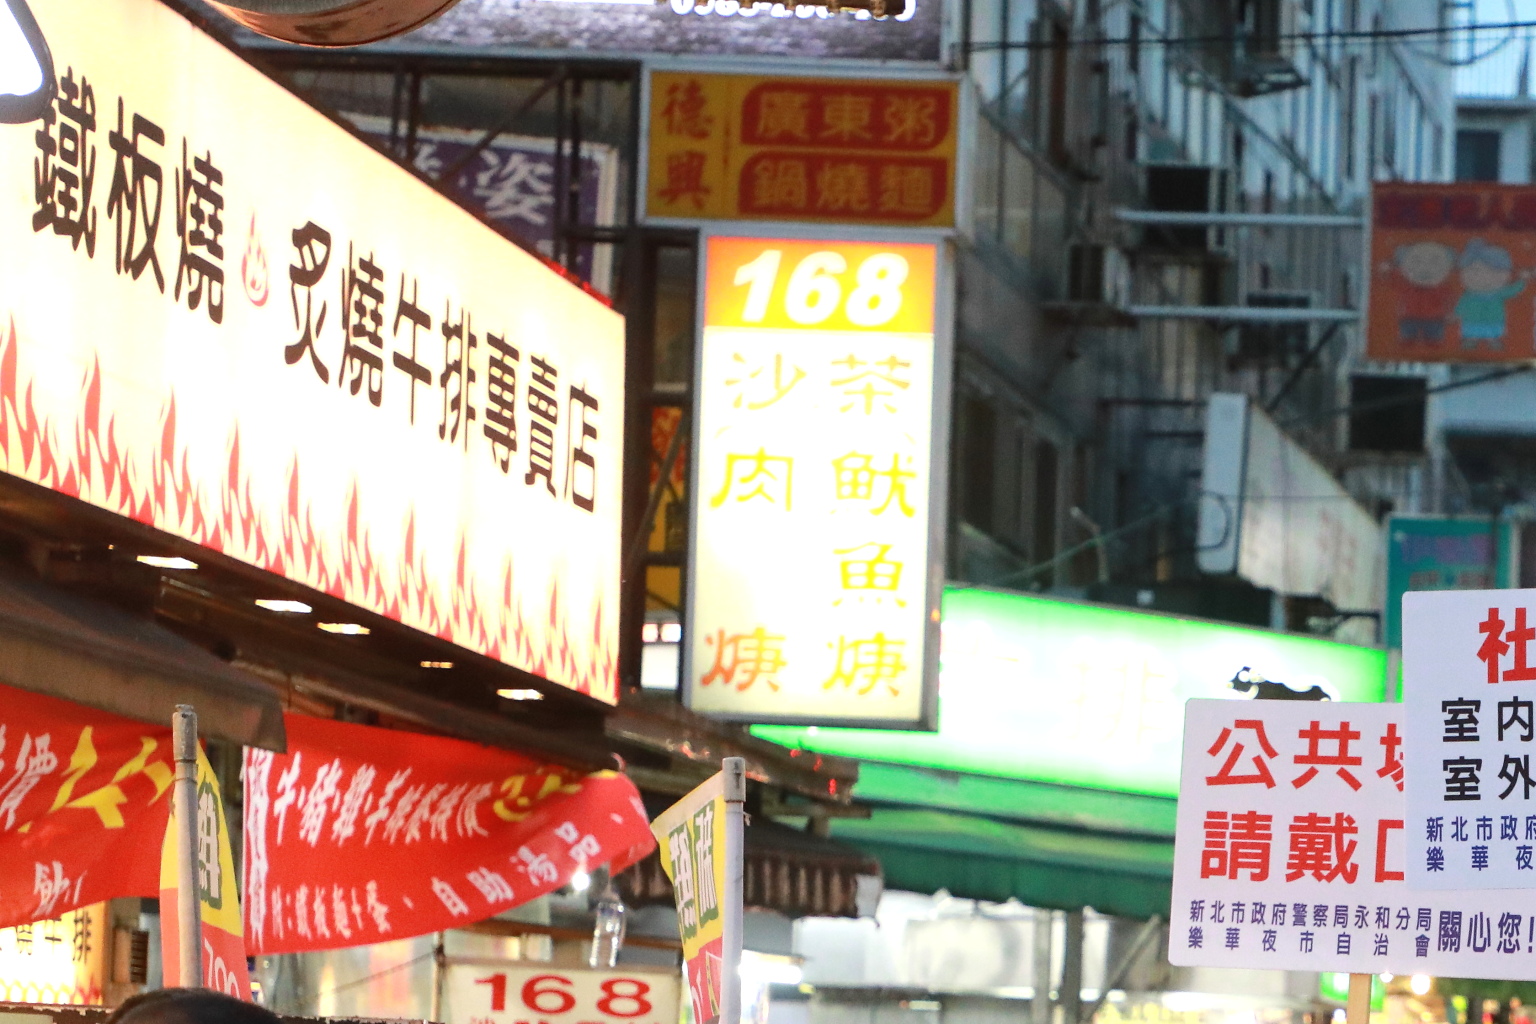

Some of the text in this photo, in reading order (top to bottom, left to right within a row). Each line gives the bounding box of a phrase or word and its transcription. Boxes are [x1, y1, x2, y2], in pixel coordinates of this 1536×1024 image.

[756, 88, 938, 144] 廣東粥
[31, 67, 224, 324] 鐵板燒
[733, 249, 910, 327] 168
[286, 220, 600, 513] 炙燒牛排專賣店
[1188, 926, 1431, 957] 樂華夜市自治會
[1190, 900, 1432, 931] 新北市政府警察局永和分局
[474, 972, 653, 1018] 168
